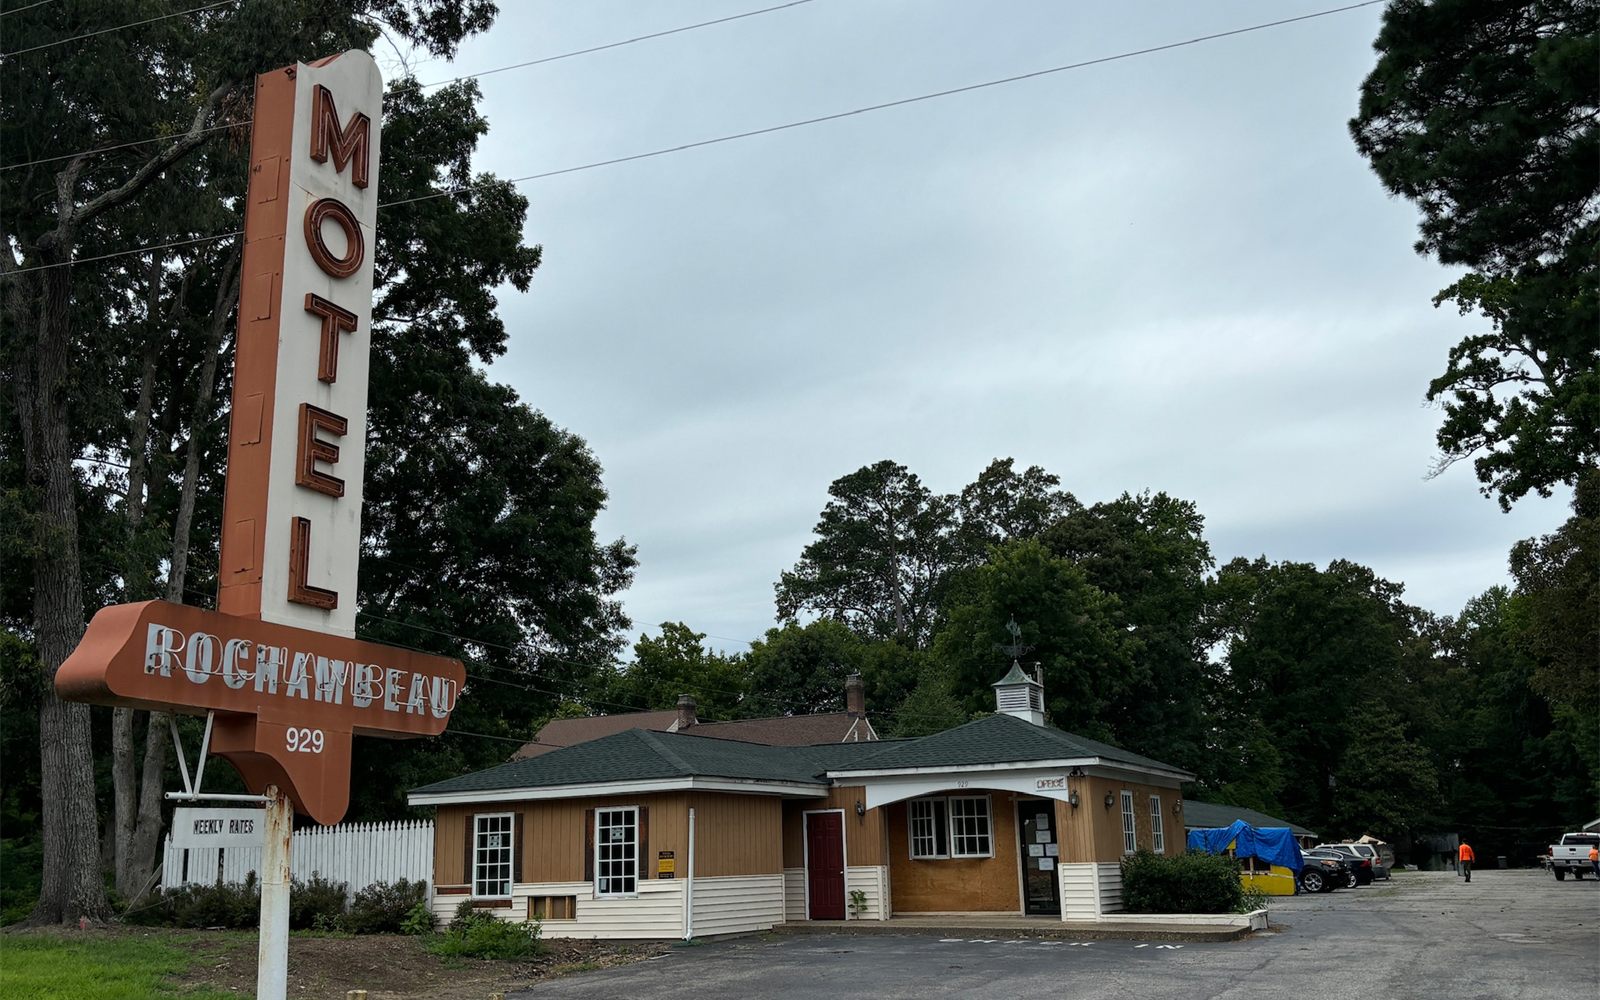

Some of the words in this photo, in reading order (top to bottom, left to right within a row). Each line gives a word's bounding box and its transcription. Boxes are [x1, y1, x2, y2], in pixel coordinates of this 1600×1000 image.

[287, 83, 370, 610] MOTEL
[144, 623, 457, 719] ROCHAMBEAU
[286, 727, 324, 753] 929
[957, 779, 969, 788] 929
[1036, 778, 1064, 789] OFFICE
[193, 819, 224, 834] WEEKLY
[229, 819, 254, 834] RATES
